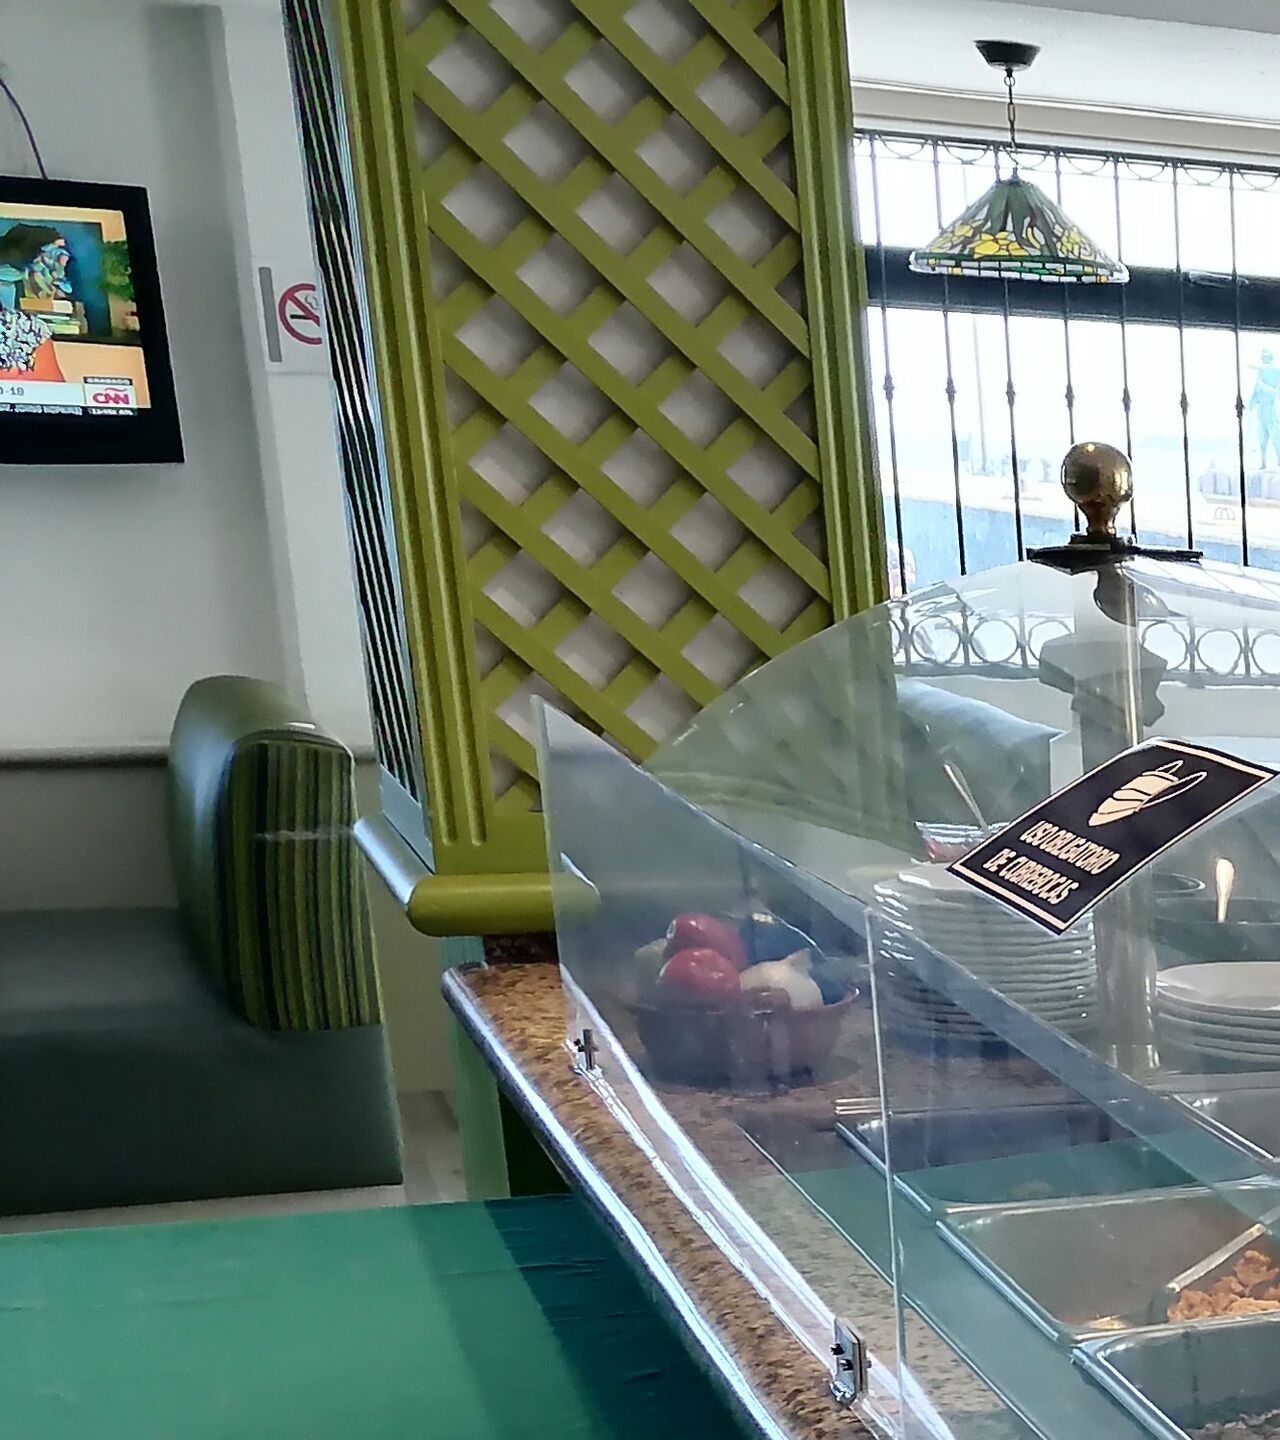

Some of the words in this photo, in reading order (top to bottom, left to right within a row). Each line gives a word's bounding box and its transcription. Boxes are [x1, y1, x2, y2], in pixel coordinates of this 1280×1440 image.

[93, 392, 129, 405] CNN
[1019, 820, 1060, 846] USO
[982, 848, 1017, 872] DE
[1039, 829, 1120, 875] OBLIGATORIO
[998, 856, 1079, 904] CUBREBOCAS
